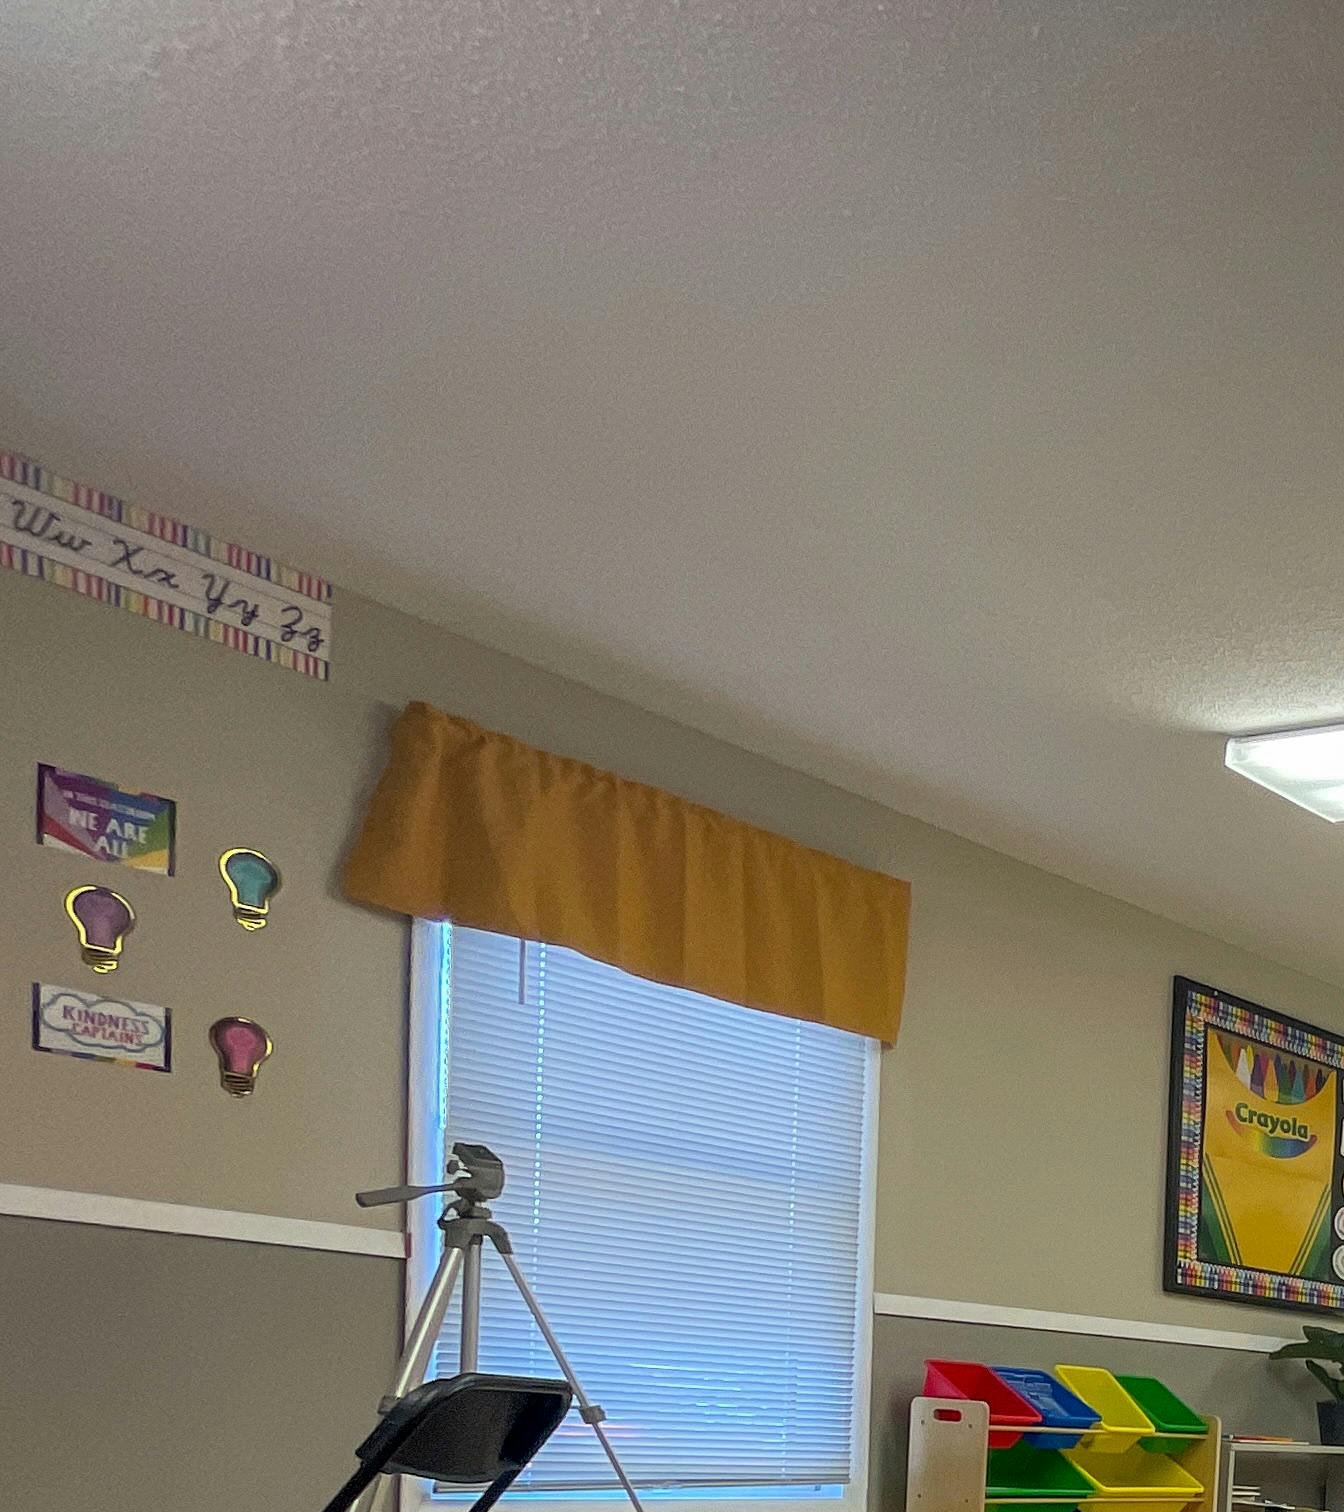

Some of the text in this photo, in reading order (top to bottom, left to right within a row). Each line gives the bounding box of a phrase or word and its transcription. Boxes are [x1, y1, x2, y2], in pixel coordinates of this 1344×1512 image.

[11, 500, 325, 652] Ww Xx Yy Zz
[106, 817, 149, 844] ARE
[62, 1005, 150, 1035] KINDNESS
[1235, 1103, 1309, 1138] Crayola
